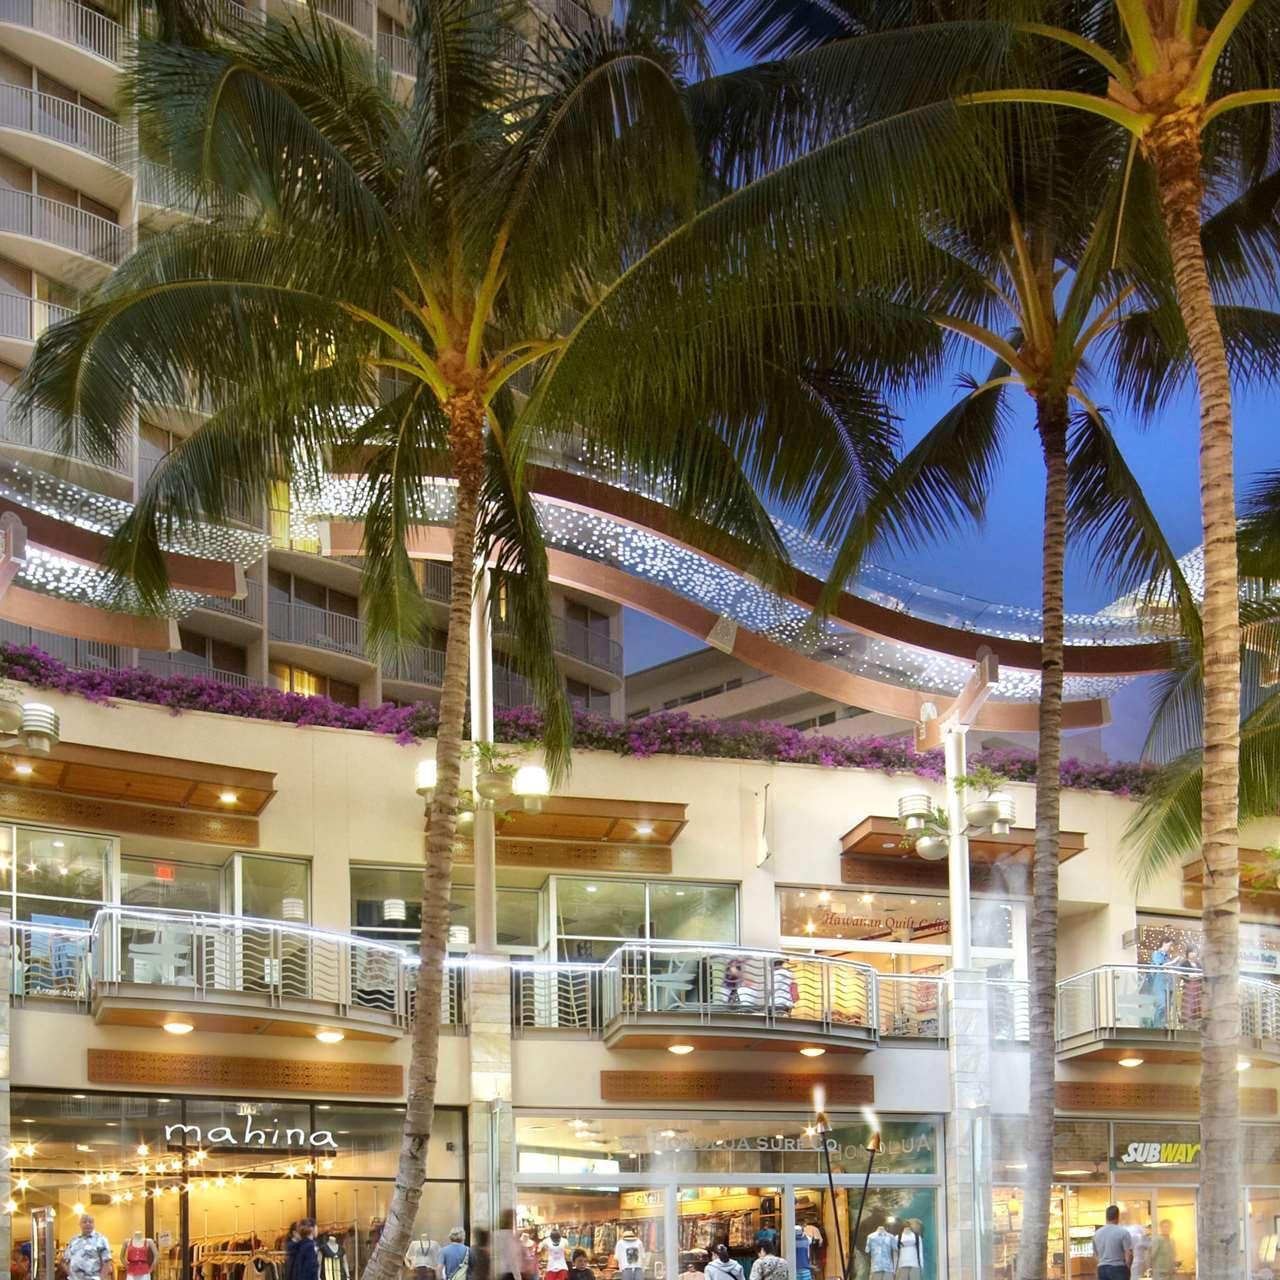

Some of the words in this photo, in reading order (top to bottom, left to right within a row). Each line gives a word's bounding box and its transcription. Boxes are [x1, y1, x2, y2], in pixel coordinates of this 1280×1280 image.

[822, 912, 881, 929] Hawaiian
[885, 916, 914, 932] Quilt
[164, 1114, 338, 1148] mahina
[1122, 1142, 1201, 1163] SUBWAY
